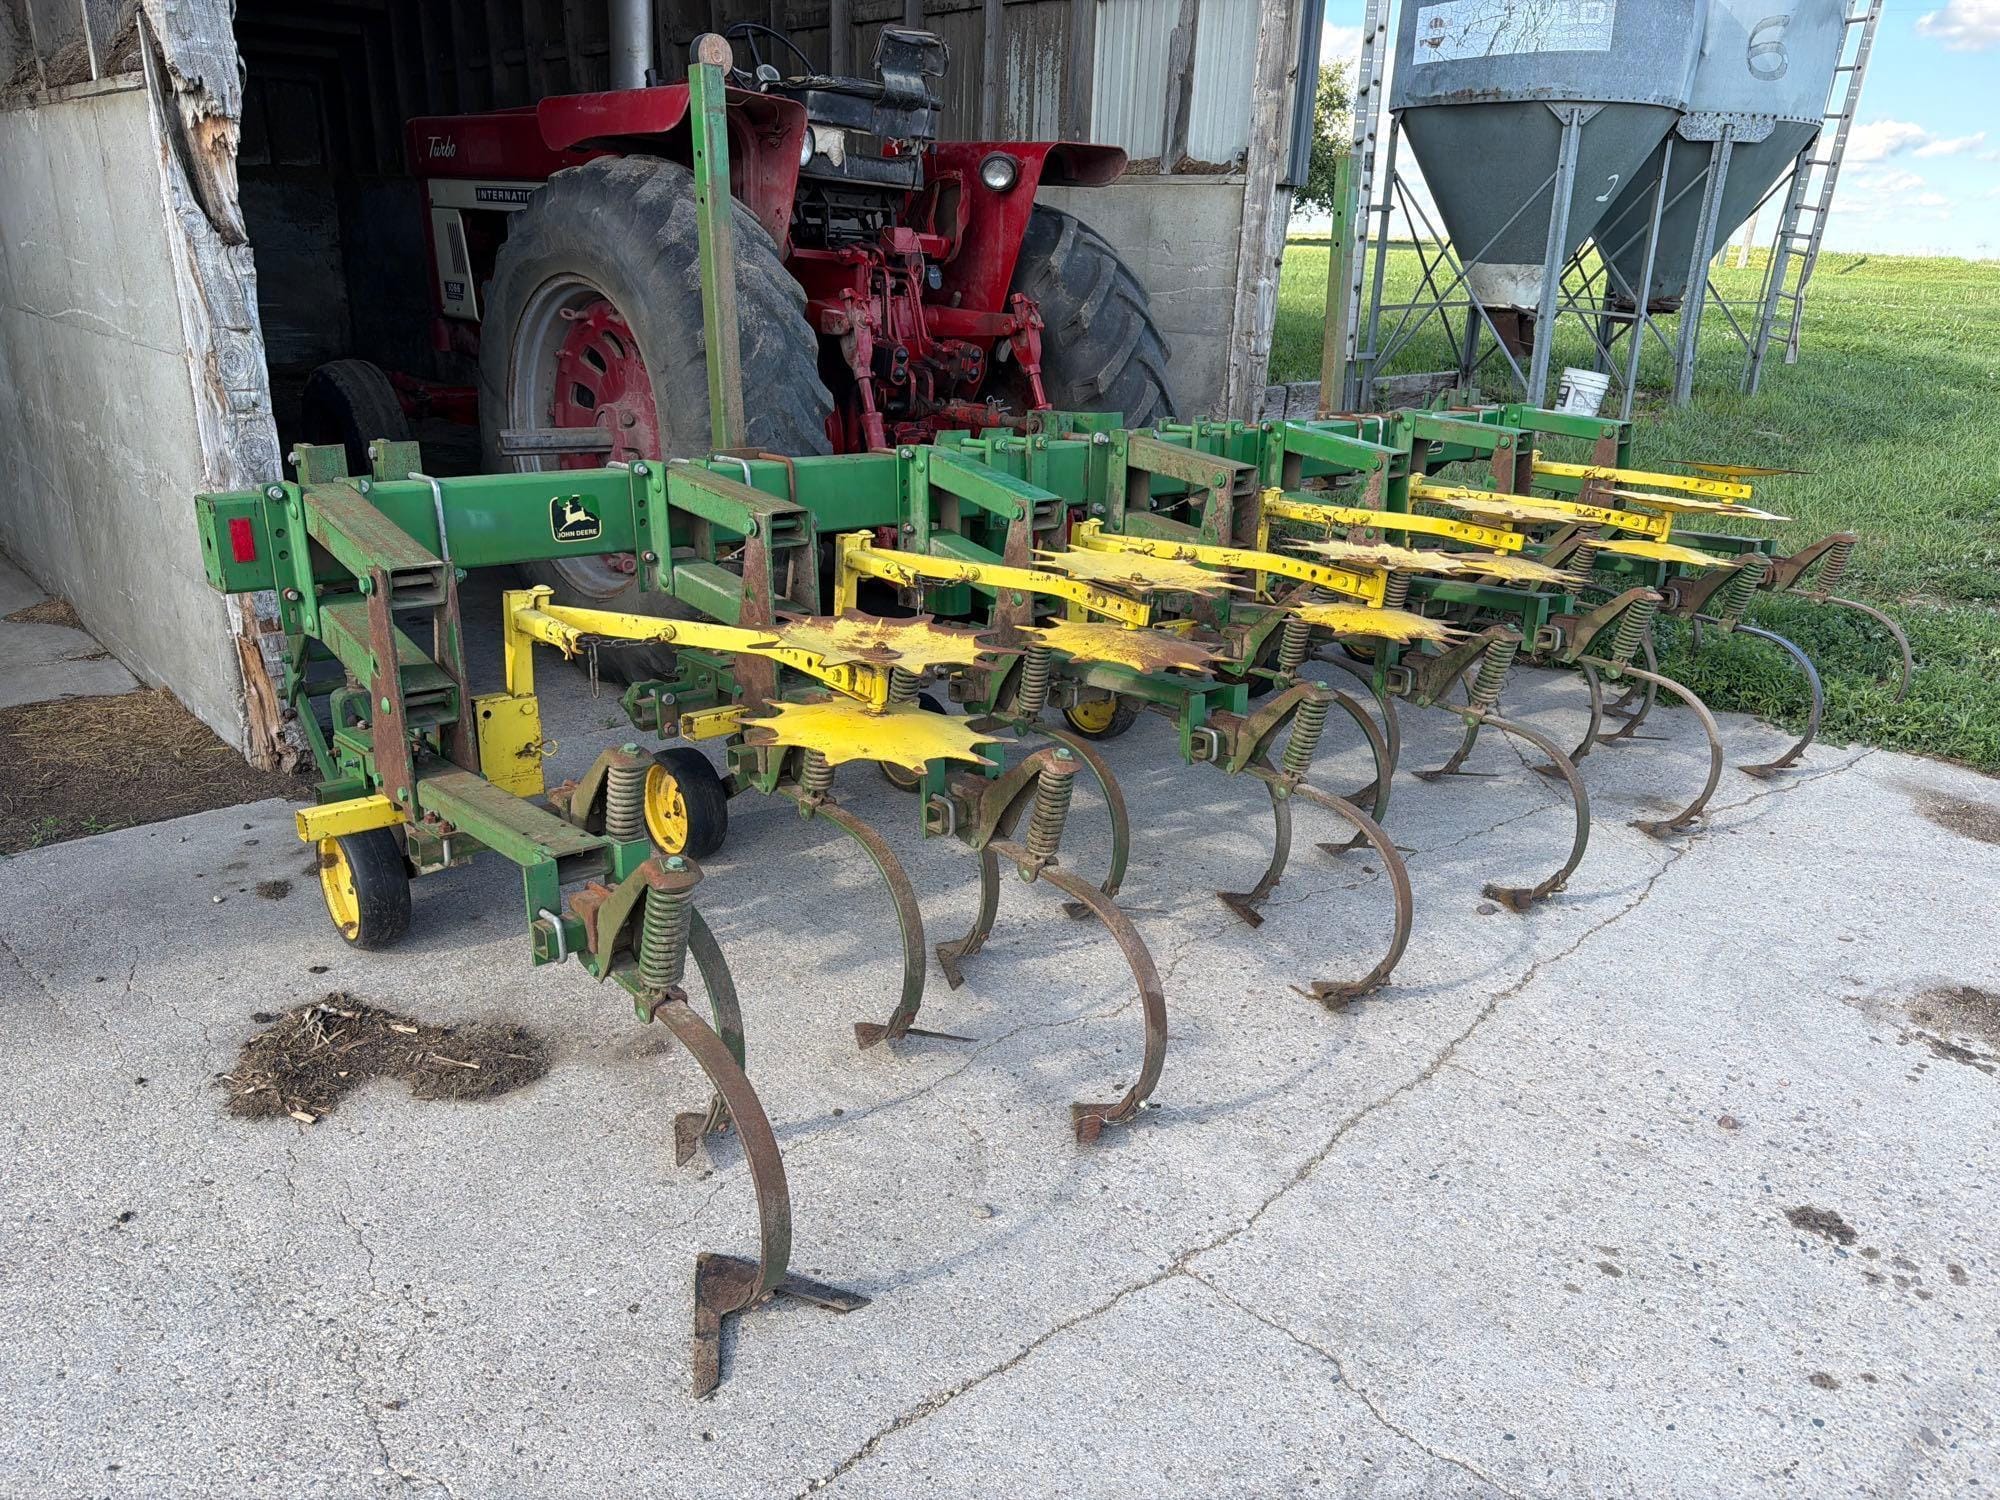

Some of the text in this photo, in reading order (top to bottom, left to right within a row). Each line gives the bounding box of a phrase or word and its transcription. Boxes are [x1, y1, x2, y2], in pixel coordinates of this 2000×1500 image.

[1747, 14, 1790, 81] 6
[427, 135, 456, 158] Turbo
[1595, 174, 1619, 201] 2
[576, 528, 597, 536] DEERE
